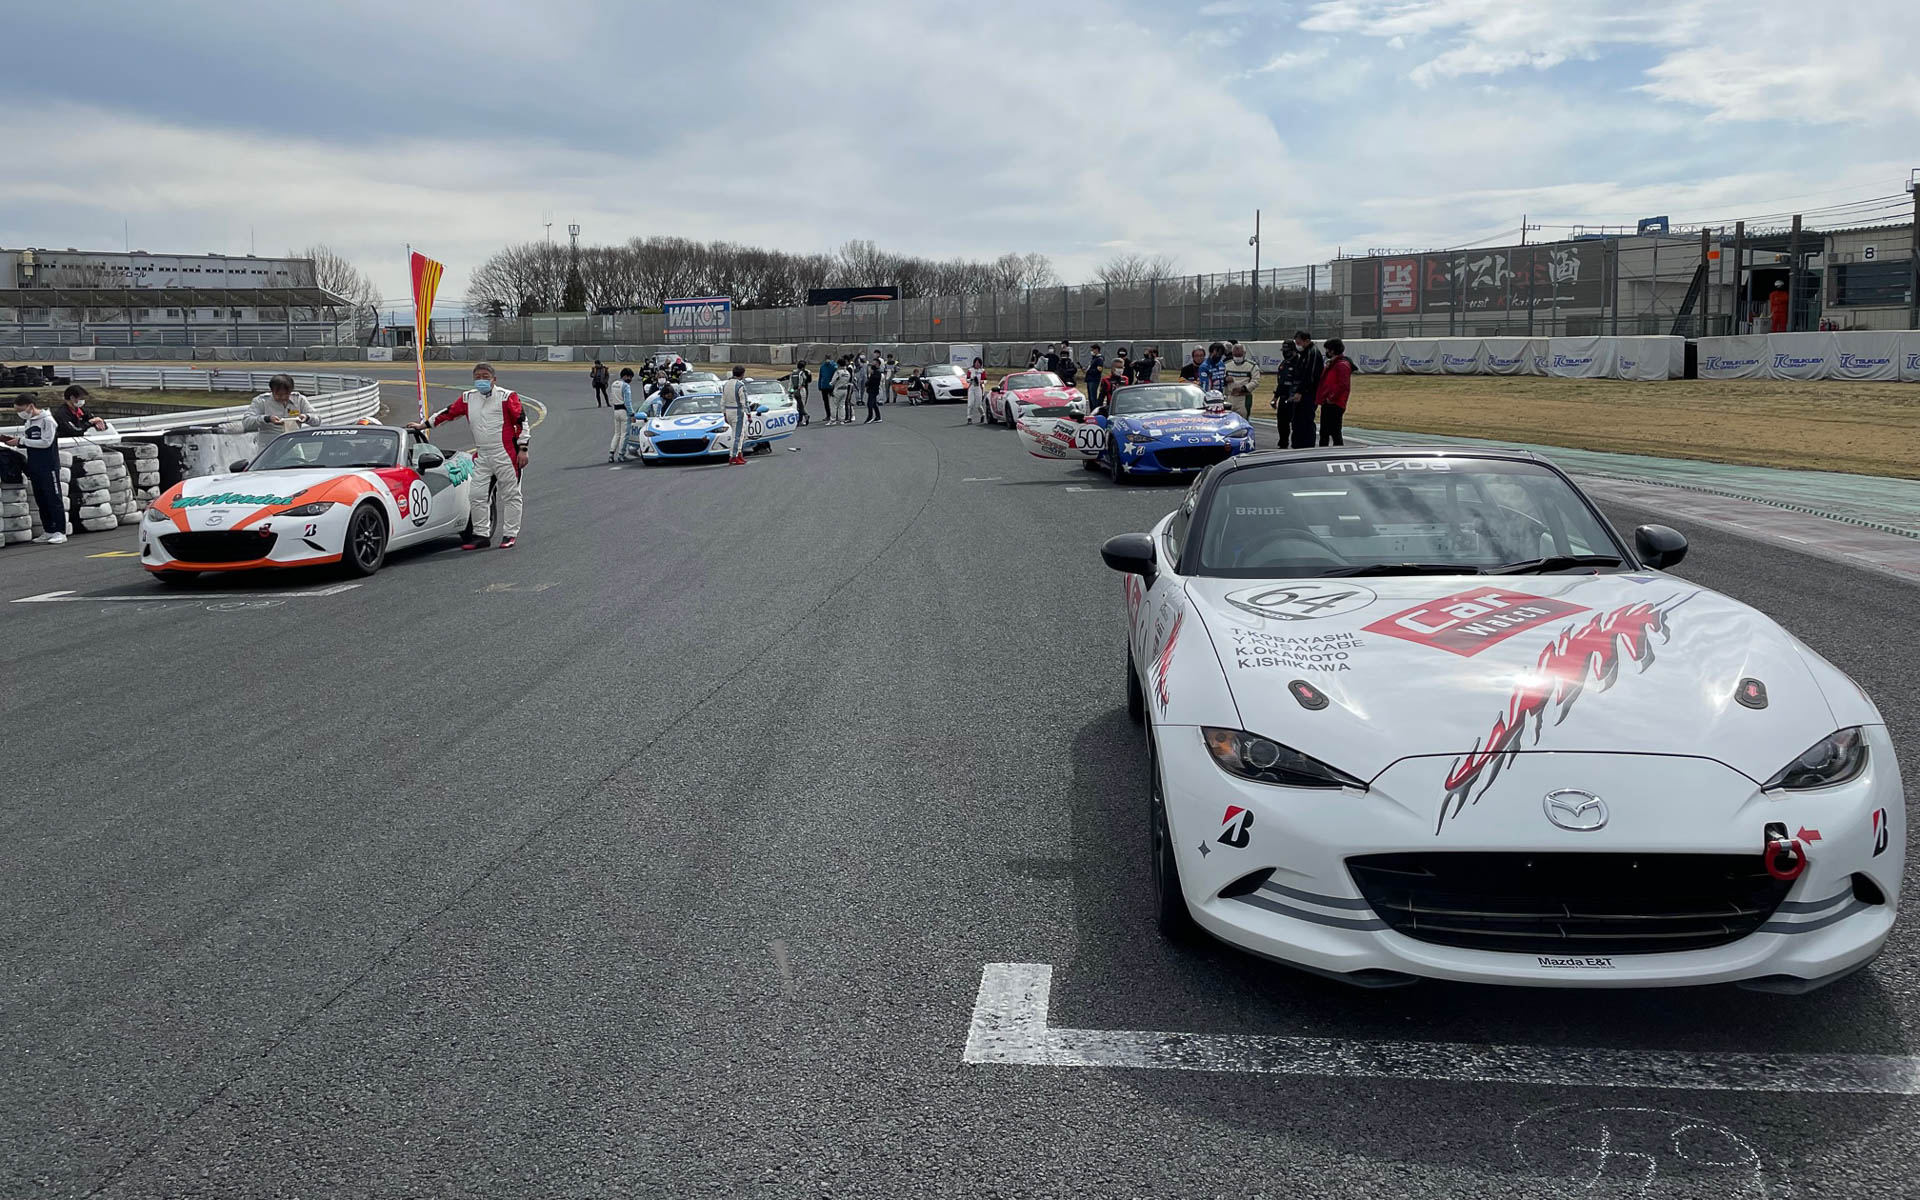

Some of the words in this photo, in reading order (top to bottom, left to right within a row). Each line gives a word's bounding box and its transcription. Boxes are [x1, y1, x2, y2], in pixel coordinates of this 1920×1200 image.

[1865, 247, 1875, 259] 8
[748, 421, 761, 435] 60
[766, 417, 786, 429] CAR
[1079, 429, 1105, 448] 500
[1326, 461, 1451, 472] mazda
[412, 486, 428, 517] 86
[1235, 506, 1286, 515] BRIDE
[1247, 586, 1360, 614] 64
[1395, 594, 1511, 634] Car
[1457, 605, 1551, 636] Watch
[1231, 627, 1354, 645] T.KOBAYASHI
[1232, 636, 1366, 652] Y.KUSAKABE
[1235, 647, 1349, 662] K.OKAMOTO
[1238, 657, 1351, 672] K.ISHIKAWA
[1537, 957, 1584, 967] Mazda
[1585, 958, 1612, 967] E&T
